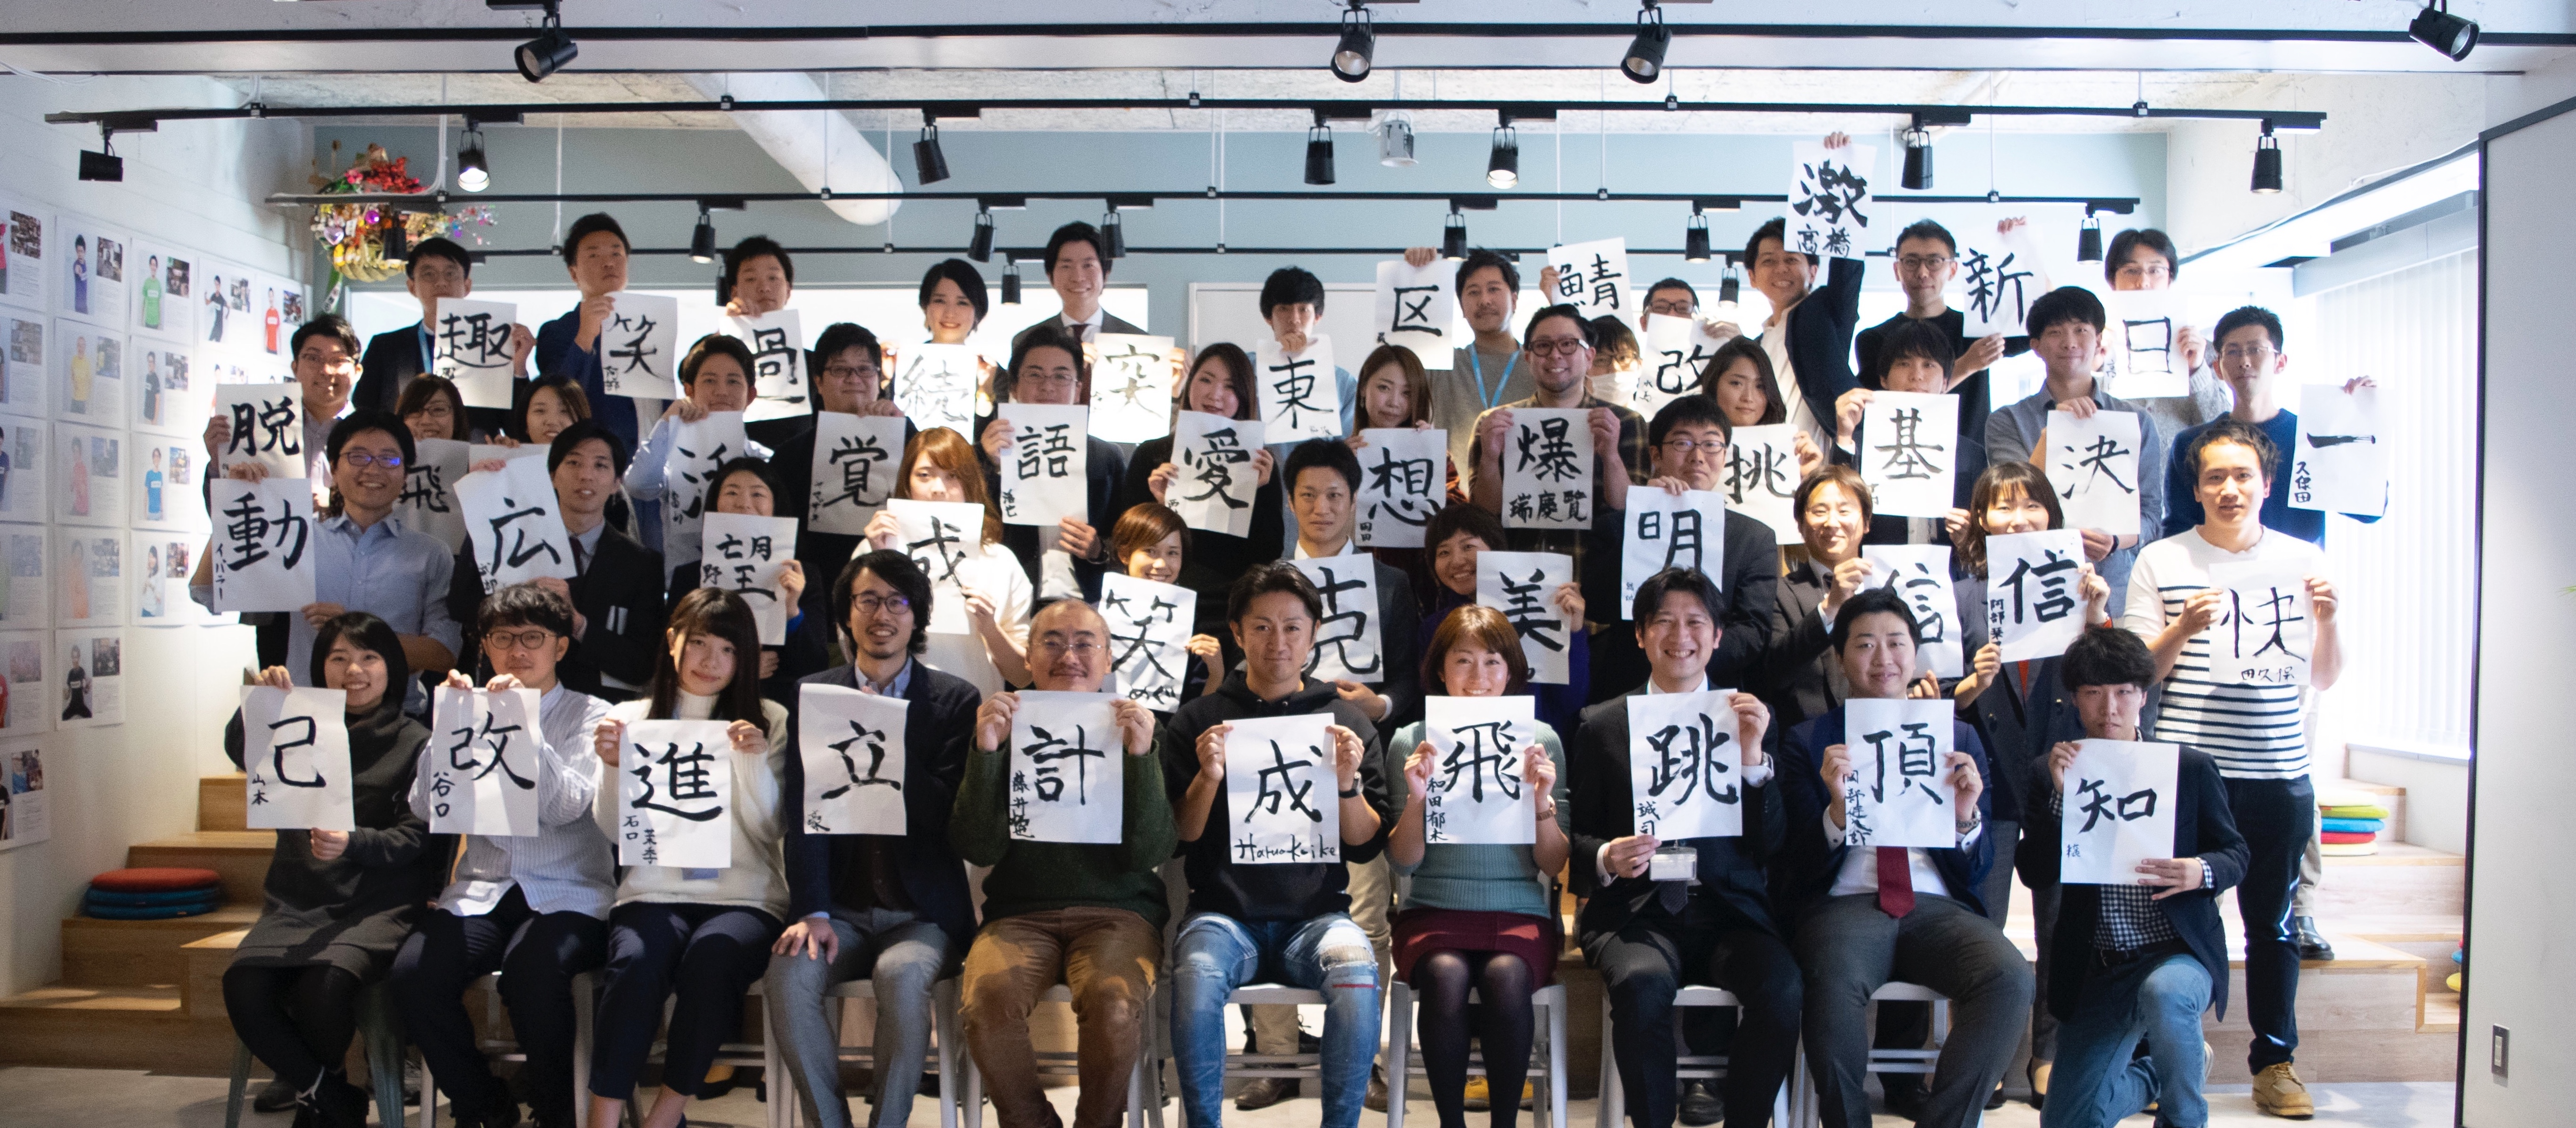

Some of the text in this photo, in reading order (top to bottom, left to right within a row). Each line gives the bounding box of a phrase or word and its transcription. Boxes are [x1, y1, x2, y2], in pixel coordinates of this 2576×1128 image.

[1793, 159, 1868, 228] 激
[1392, 285, 1442, 336] 区
[1559, 253, 1621, 310] 鯖
[1963, 247, 2034, 324] 新
[438, 313, 514, 368] 趣
[609, 313, 657, 378] 笑
[1657, 344, 1713, 394] 改
[2123, 316, 2172, 373] 日
[900, 354, 969, 421] 続
[1105, 344, 1163, 419] 突
[1269, 356, 1334, 428] 東
[228, 396, 299, 456] 脱
[1016, 424, 1076, 480] 語
[1517, 417, 1582, 483] 爆
[1874, 407, 1944, 481] 基
[822, 435, 888, 507] 覚
[1183, 427, 1251, 509] 愛
[1368, 446, 1442, 526] 想
[1724, 443, 1795, 504] 挑
[2061, 435, 2134, 499] 決
[2295, 461, 2310, 502] 久保田
[223, 492, 308, 571] 動
[490, 497, 561, 575] 広
[1638, 509, 1701, 568] 明
[1499, 568, 1564, 651] 美
[1999, 549, 2078, 624] 信
[1106, 589, 1178, 679] 笑
[2220, 587, 2305, 662] 快
[2241, 666, 2295, 683] 田久保
[268, 715, 326, 788] 己
[450, 710, 535, 790] 改
[630, 742, 724, 821] 進
[820, 719, 901, 799] 立
[1021, 724, 1105, 805] 計
[1244, 739, 1323, 824] 成
[1442, 720, 1521, 803] 飛
[1646, 712, 1739, 806] 跳
[1863, 723, 1943, 806] 頂
[251, 774, 268, 806] 山本
[431, 771, 455, 817] 谷口
[1637, 801, 1660, 836] 誠司
[2076, 778, 2157, 834] 知
[623, 815, 639, 840] 石口
